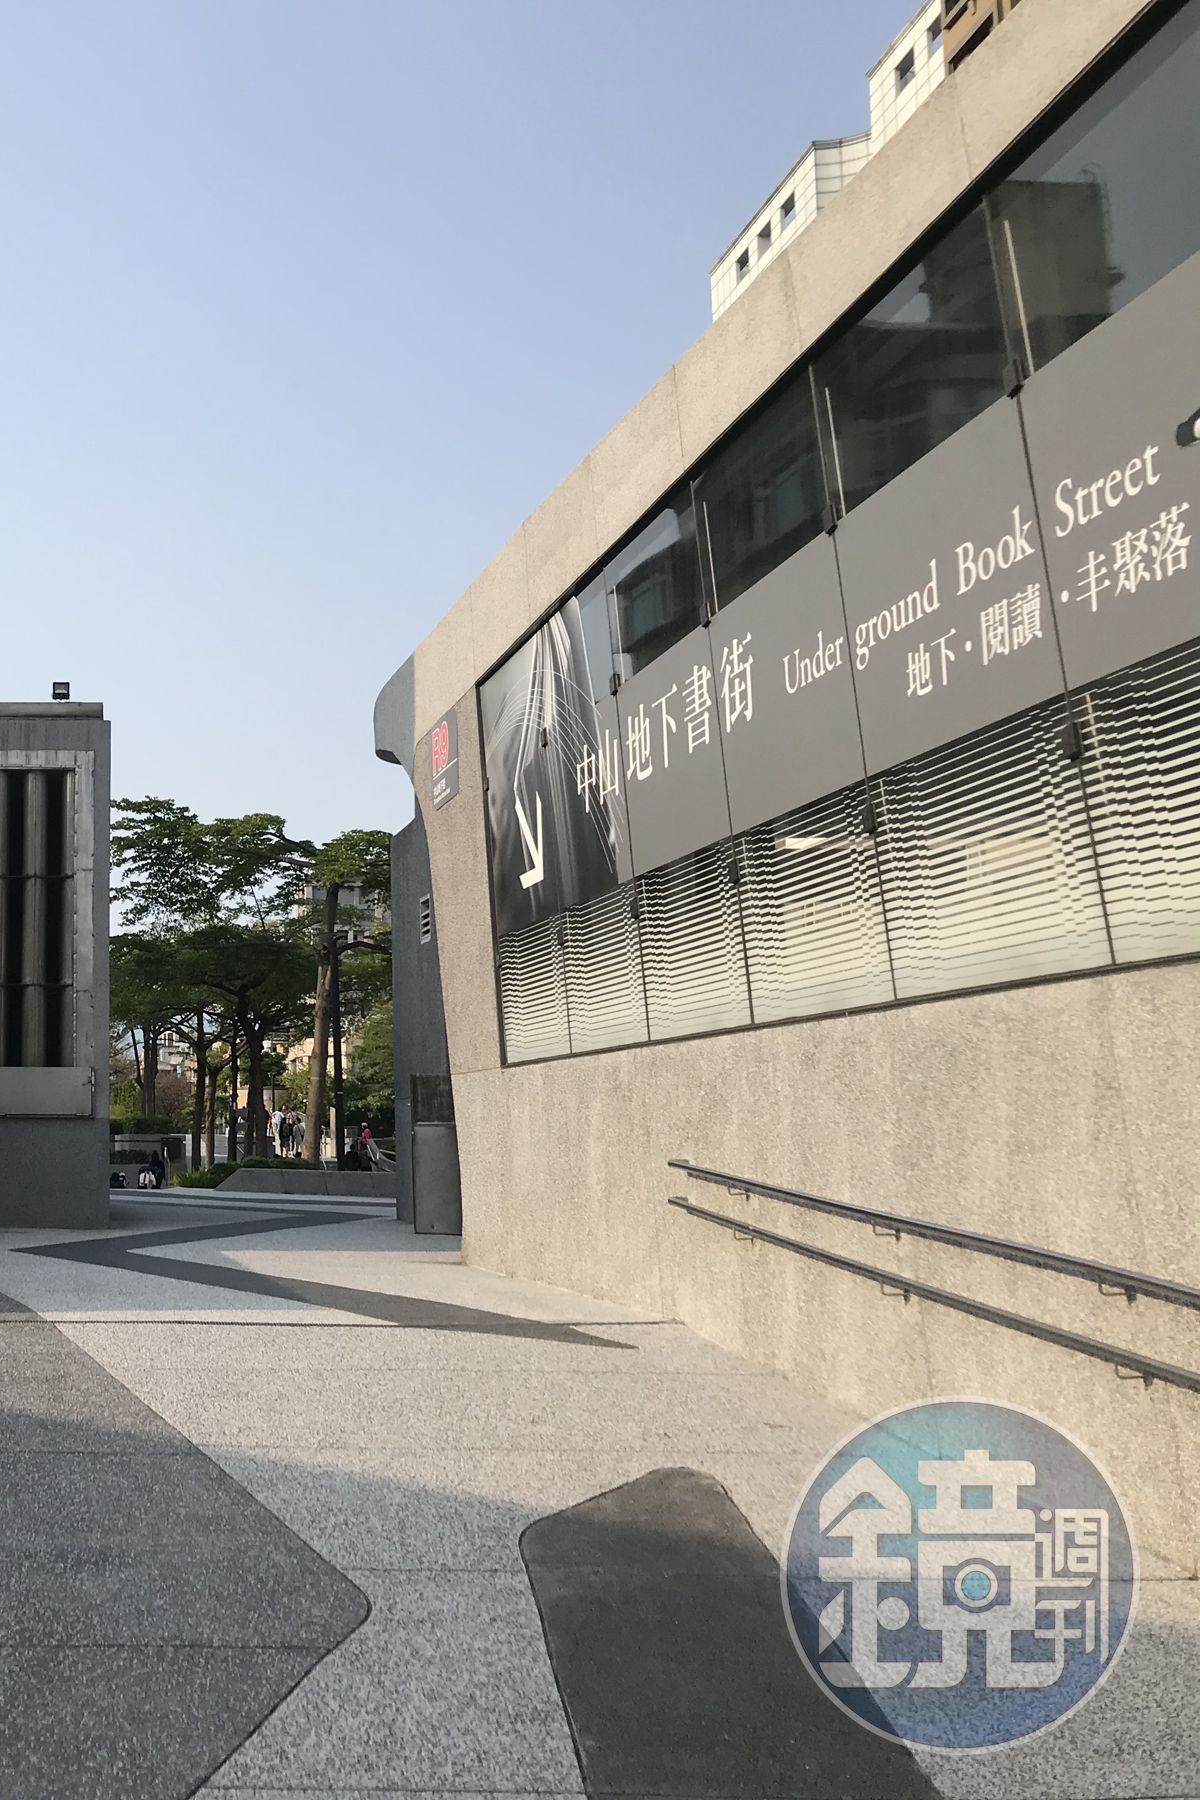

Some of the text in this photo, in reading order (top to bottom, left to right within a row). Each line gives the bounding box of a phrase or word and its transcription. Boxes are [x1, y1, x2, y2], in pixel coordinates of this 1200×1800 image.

[782, 445, 1161, 694] Under ground Book Street
[431, 720, 449, 777] R9
[576, 631, 754, 813] 中山地下書街
